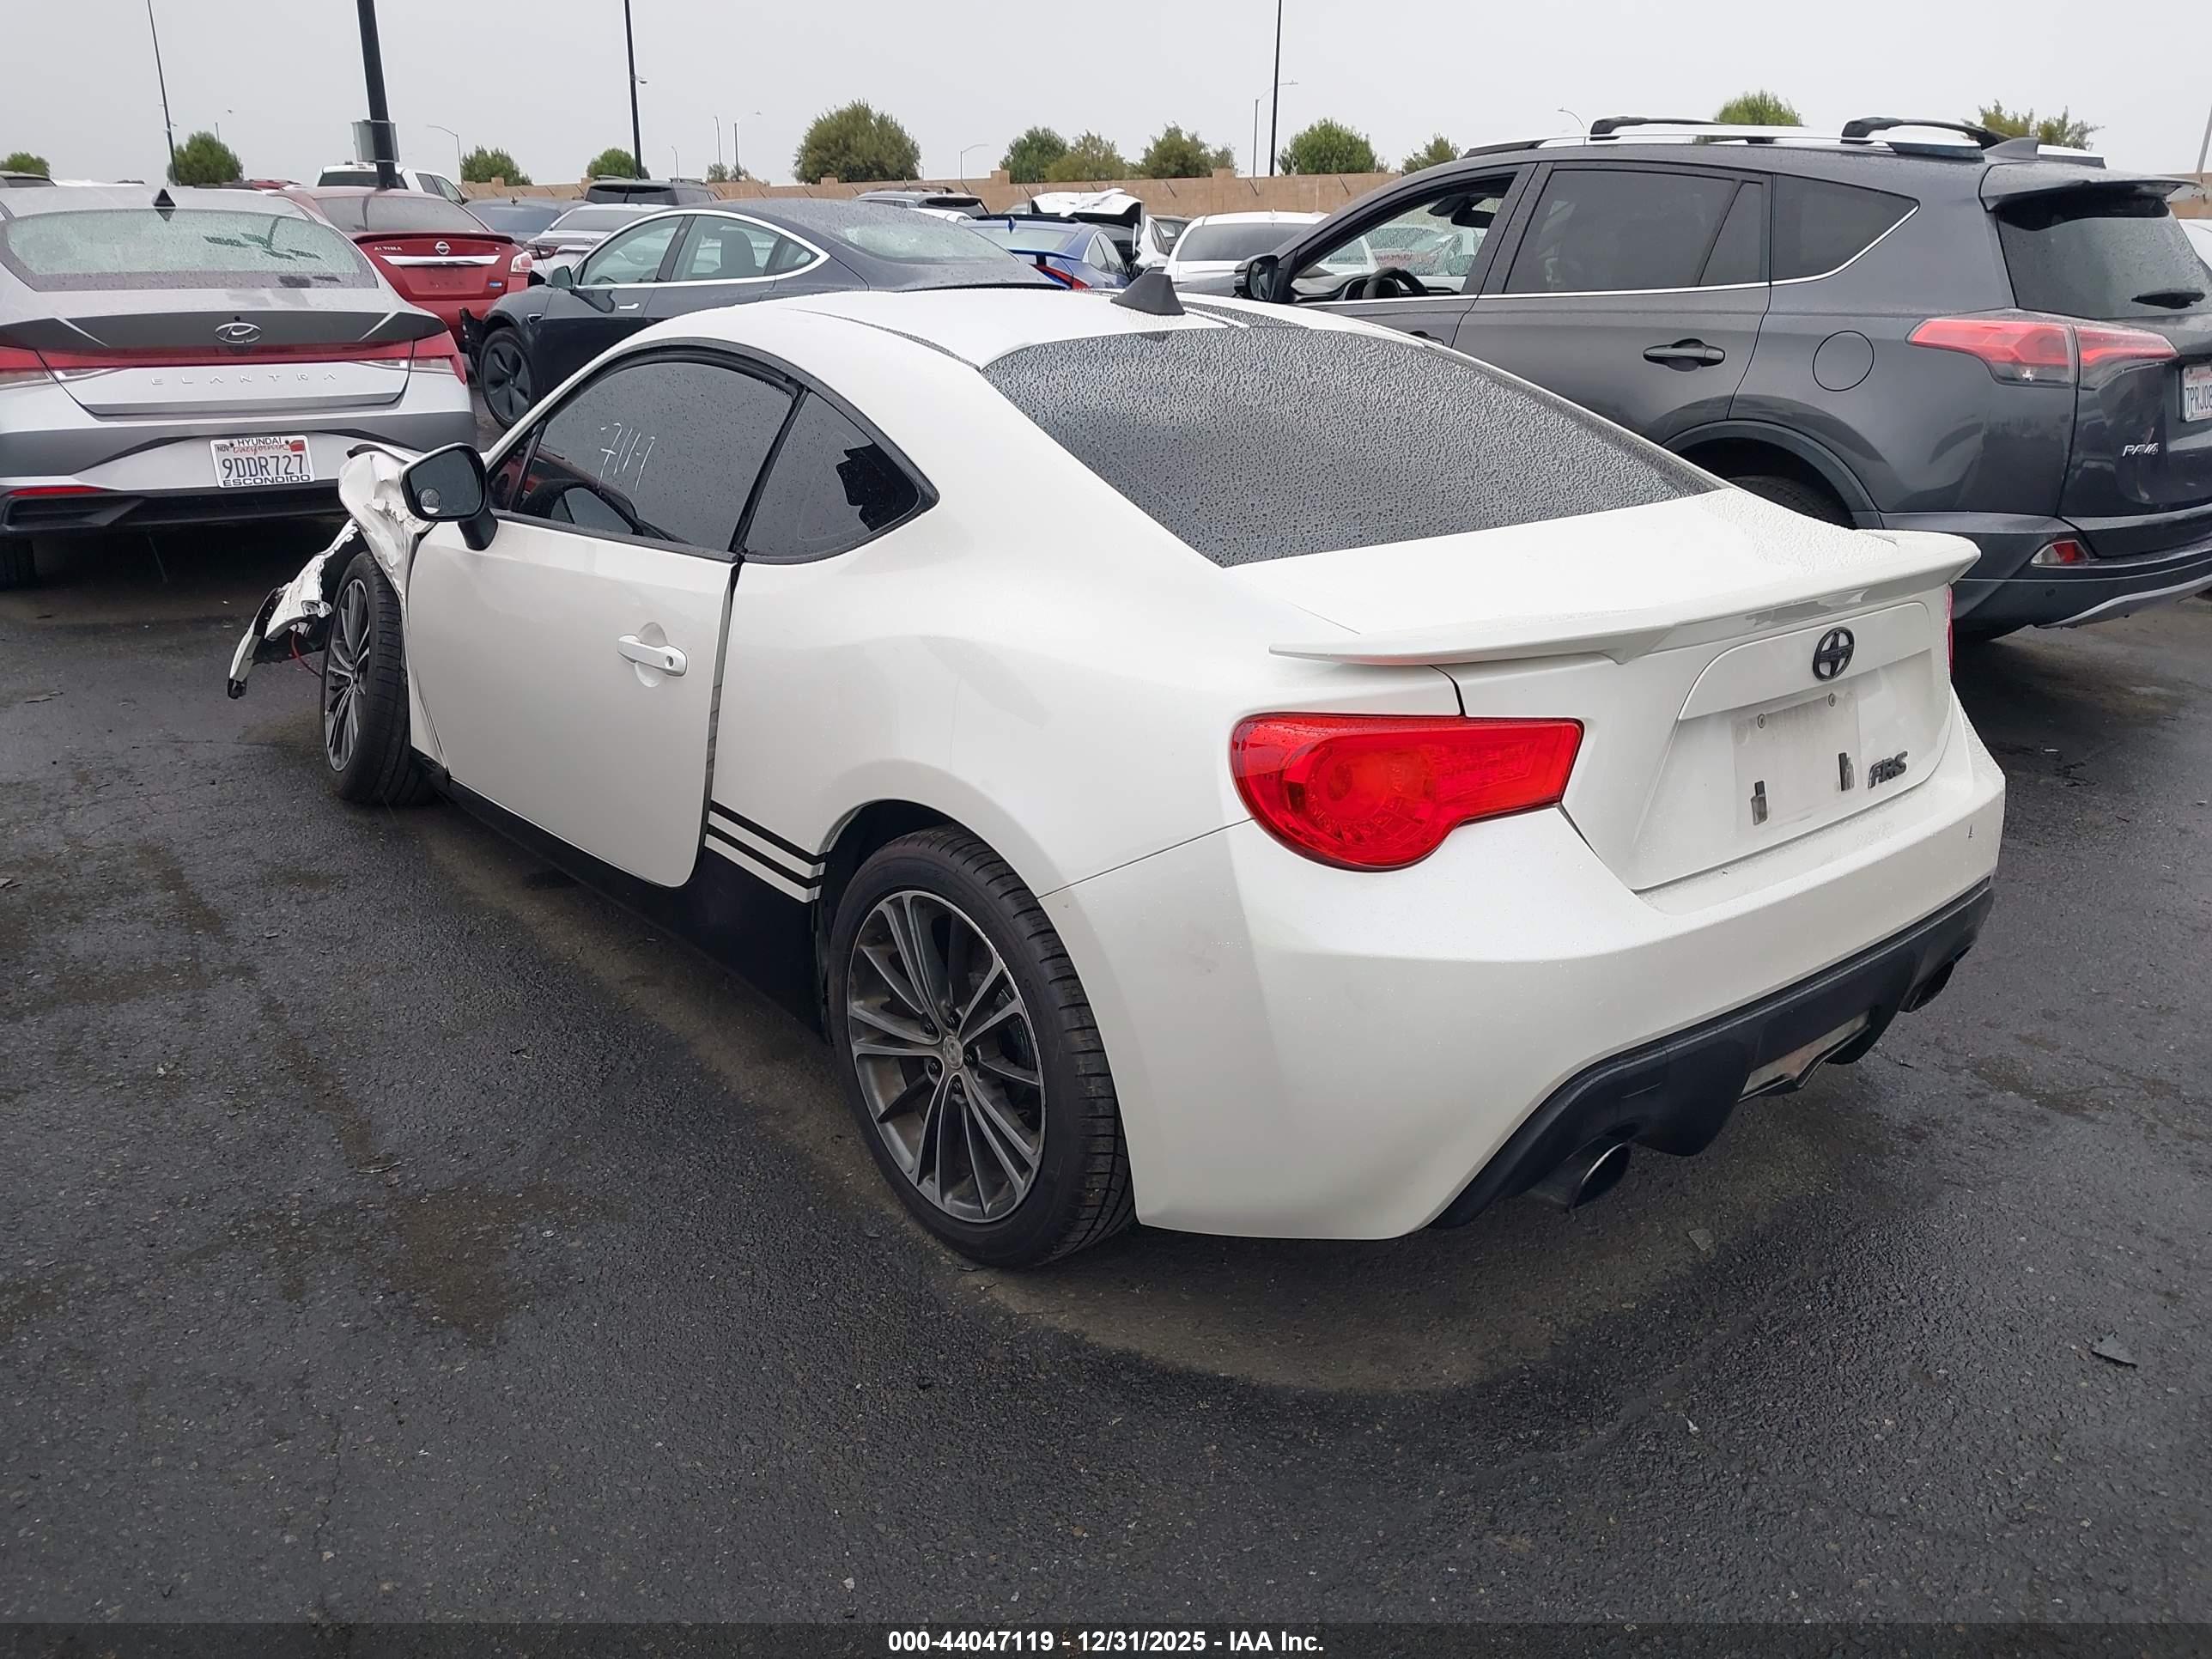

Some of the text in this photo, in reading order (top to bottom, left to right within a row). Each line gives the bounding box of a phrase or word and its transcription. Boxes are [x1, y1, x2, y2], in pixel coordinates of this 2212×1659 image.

[150, 371, 337, 386] ELANTRA
[237, 436, 282, 447] HYUNDAI
[222, 453, 304, 479] 9DDR727
[223, 474, 312, 487] ESCONDIDO
